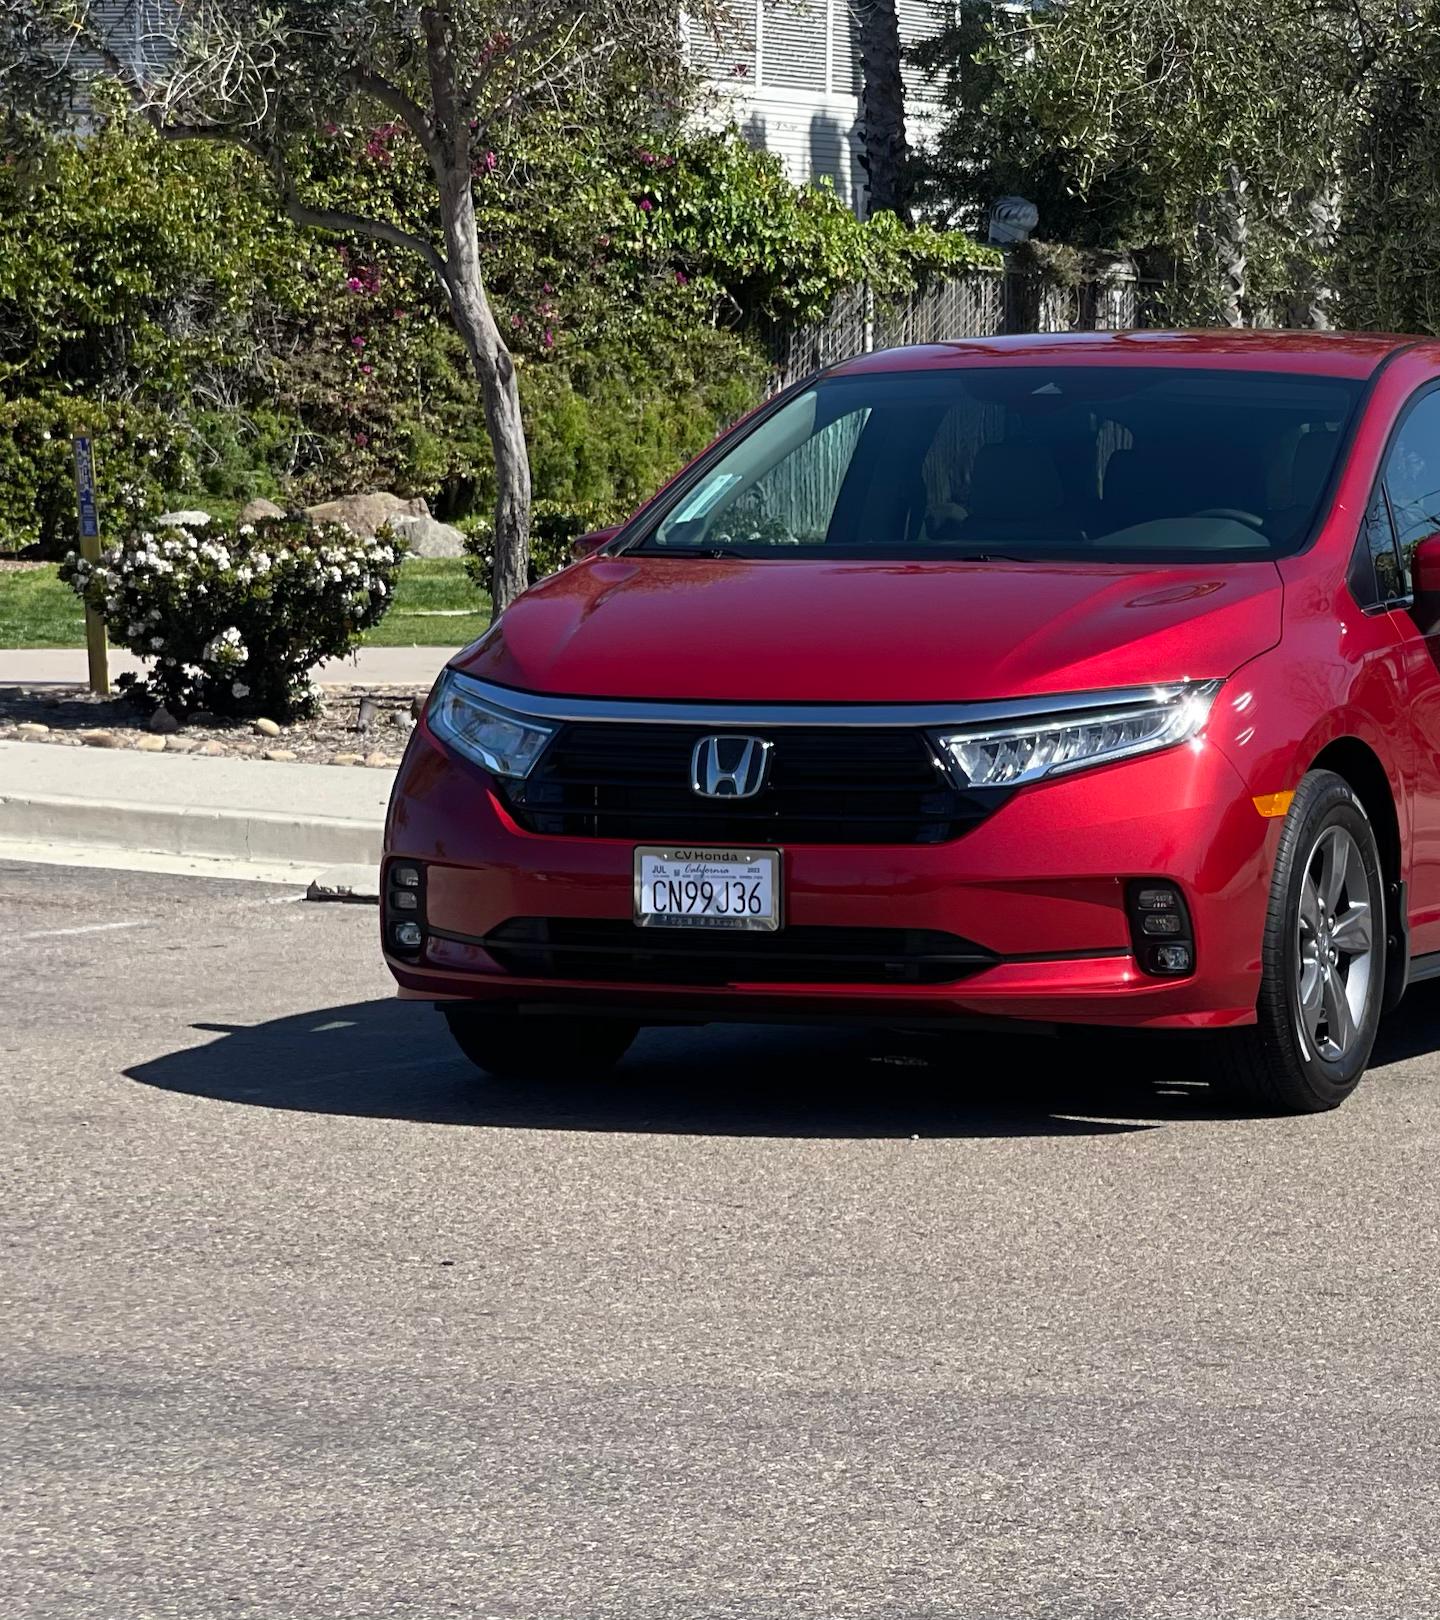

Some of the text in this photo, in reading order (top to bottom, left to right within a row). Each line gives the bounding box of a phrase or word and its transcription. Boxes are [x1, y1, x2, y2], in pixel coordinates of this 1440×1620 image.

[674, 850, 738, 862] CV Honda
[652, 865, 667, 874] JUL
[684, 863, 730, 878] California
[652, 880, 762, 914] CN99J36
